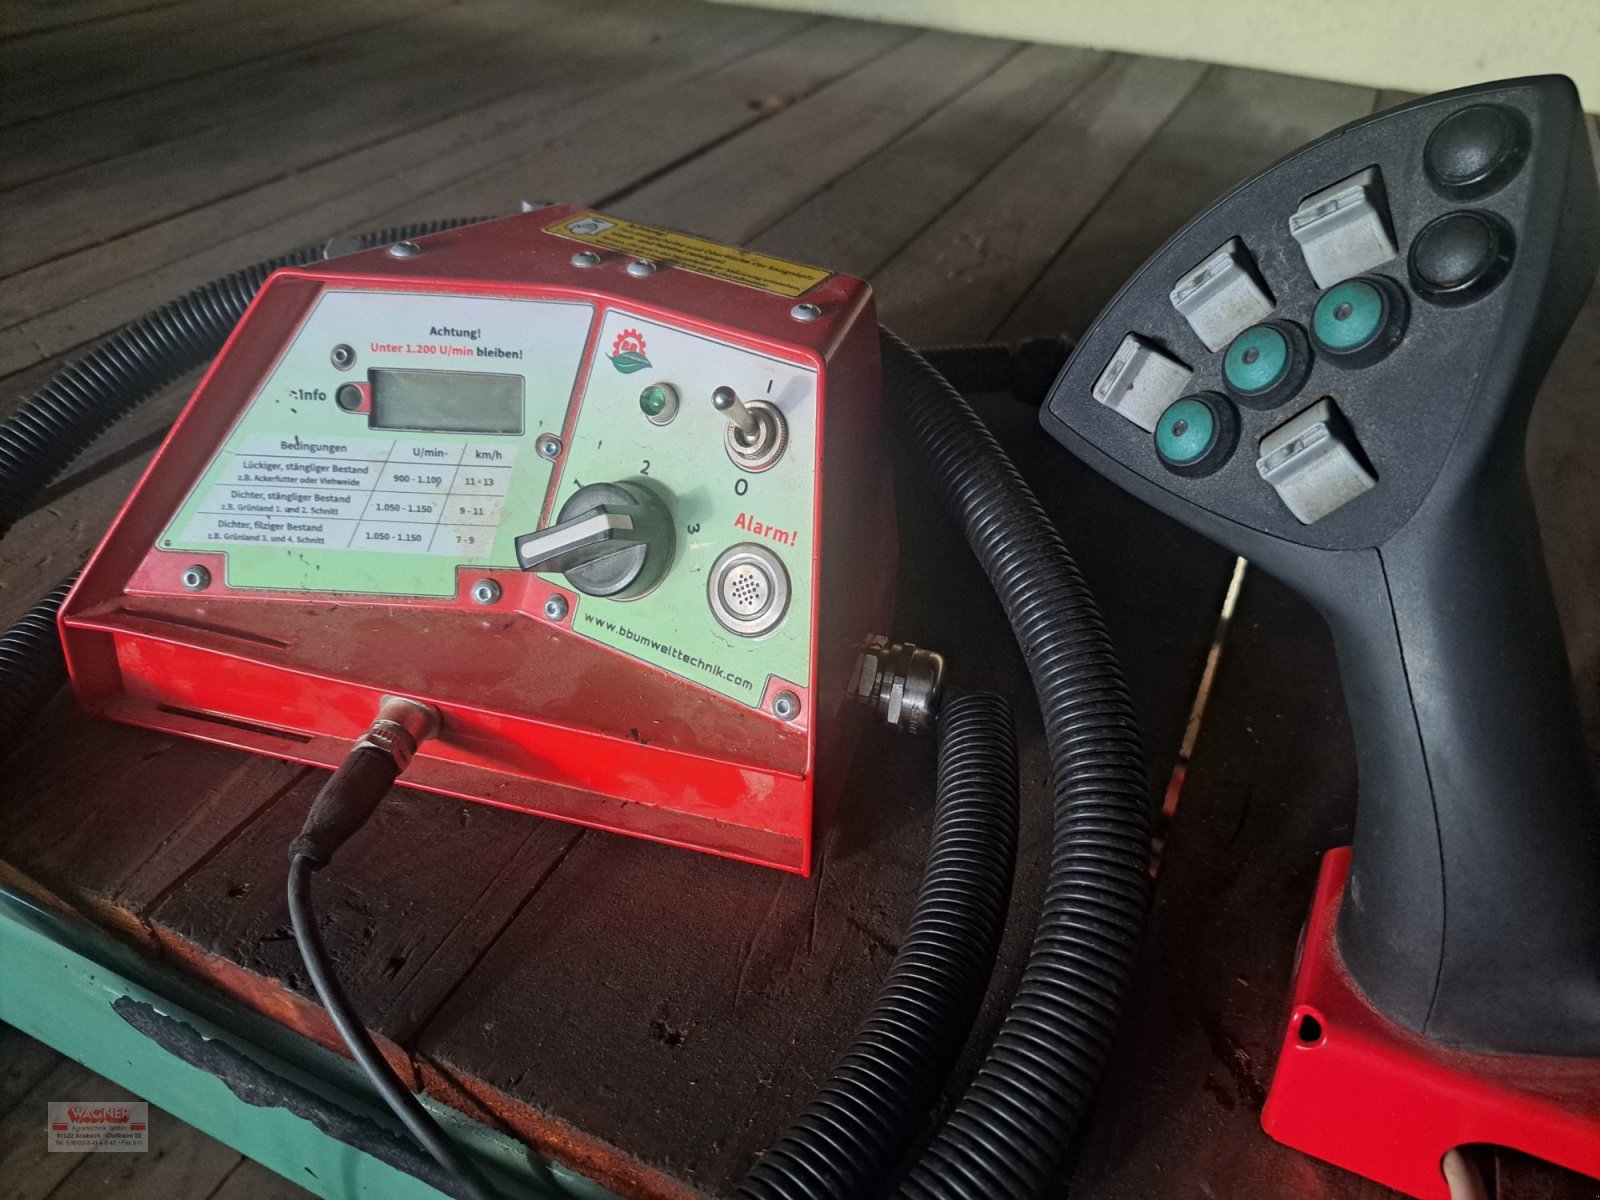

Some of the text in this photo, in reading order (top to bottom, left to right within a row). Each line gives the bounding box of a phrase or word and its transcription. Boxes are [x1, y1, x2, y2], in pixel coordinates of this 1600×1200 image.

[430, 326, 481, 340] Achtung!
[370, 342, 523, 359] Unter 1.200 U/min bleiben!
[299, 388, 327, 401] Info
[280, 440, 347, 454] Bedingungen
[475, 450, 502, 461] km/h
[243, 461, 369, 474] Lückiger, stängliger Bestand
[640, 460, 650, 475] 2
[254, 474, 298, 483] Ackerfutter
[299, 476, 318, 484] oder
[319, 477, 361, 486] Viehweide
[393, 474, 410, 483] 900
[417, 475, 442, 484] 1.100
[465, 477, 475, 486] 11
[484, 478, 494, 486] 13
[231, 490, 351, 503] Dichter, stängliger Bestand
[221, 503, 236, 511] z.B.
[238, 503, 274, 512] Grünland
[284, 506, 300, 514] und
[310, 507, 339, 515] Schnitt
[376, 503, 401, 511] 1.050
[408, 504, 433, 513] 1.150
[459, 506, 465, 515] 9
[473, 507, 484, 515] 11
[218, 519, 323, 532] Dichter, filziger Bestand
[687, 523, 700, 535] 3
[734, 512, 798, 547] Alarm!
[208, 532, 223, 540] z.B.
[224, 532, 260, 542] Grünland
[271, 535, 286, 543] und
[287, 535, 295, 543] 4.
[296, 536, 325, 544] Schnitt
[366, 532, 390, 541] 1.050
[397, 533, 422, 542] 1.150
[456, 535, 462, 544] 7
[469, 536, 475, 544] 9
[584, 612, 754, 690] www.bbumwelttechnik.com
